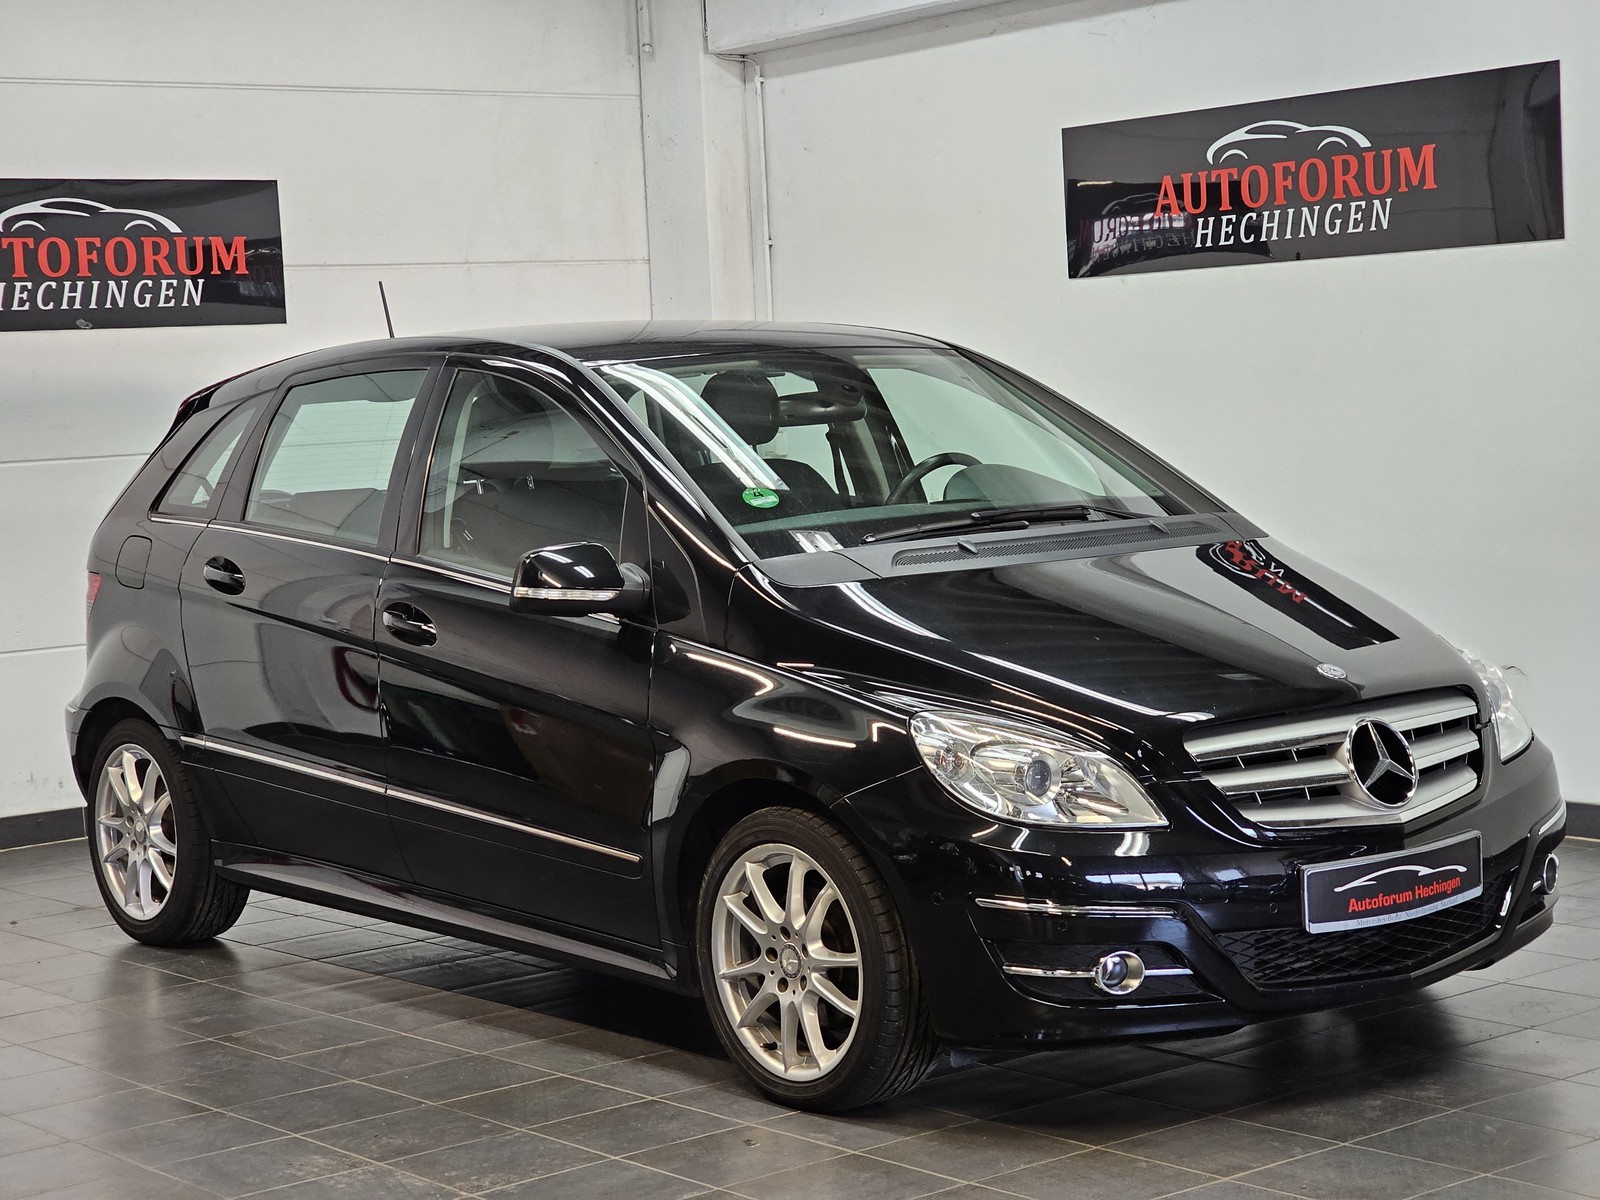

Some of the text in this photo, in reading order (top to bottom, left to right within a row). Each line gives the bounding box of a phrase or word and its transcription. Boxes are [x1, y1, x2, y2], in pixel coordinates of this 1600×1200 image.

[1154, 143, 1437, 217] AUTOFORUM
[1194, 197, 1393, 248] HECHINGEN
[1, 235, 249, 278] TOFORUM
[0, 278, 205, 311] ECHINGEN
[1349, 877, 1461, 912] Autoforum Hechingen
